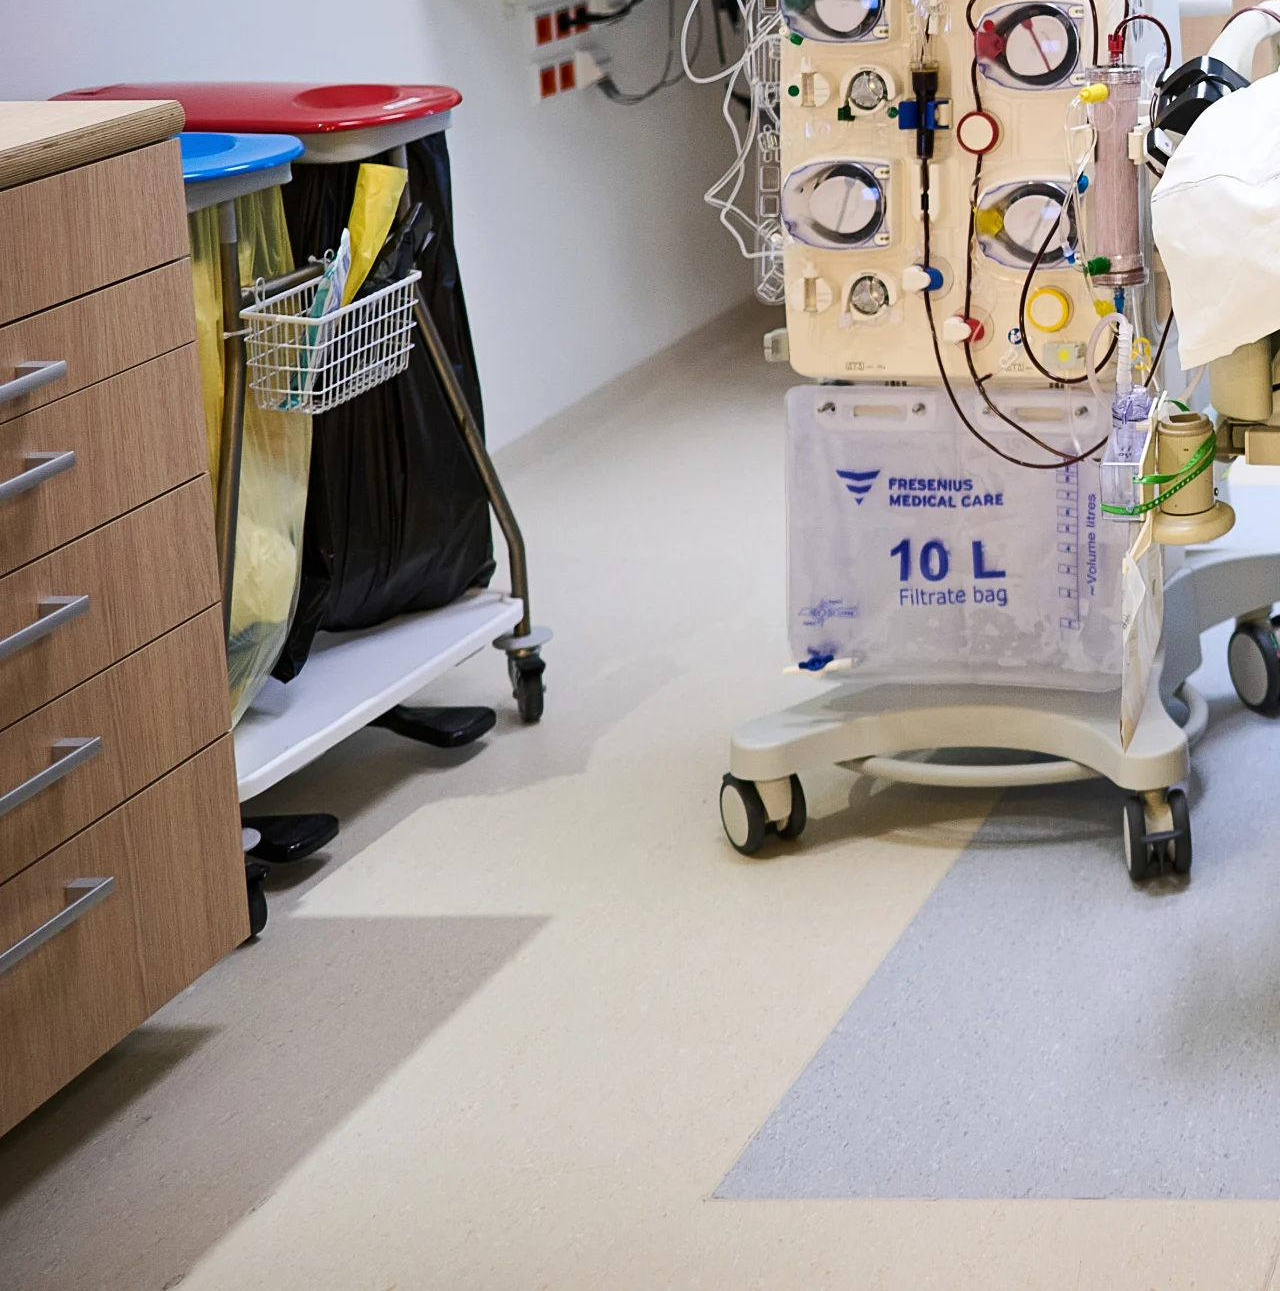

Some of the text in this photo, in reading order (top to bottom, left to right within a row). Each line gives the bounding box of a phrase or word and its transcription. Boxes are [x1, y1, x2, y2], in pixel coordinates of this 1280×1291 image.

[888, 477, 974, 493] FRESENIUS
[888, 492, 1005, 509] MEDICAL CARE
[1086, 493, 1097, 528] litres
[890, 537, 1007, 582] 10 L
[900, 584, 1009, 607] Filtrate bag
